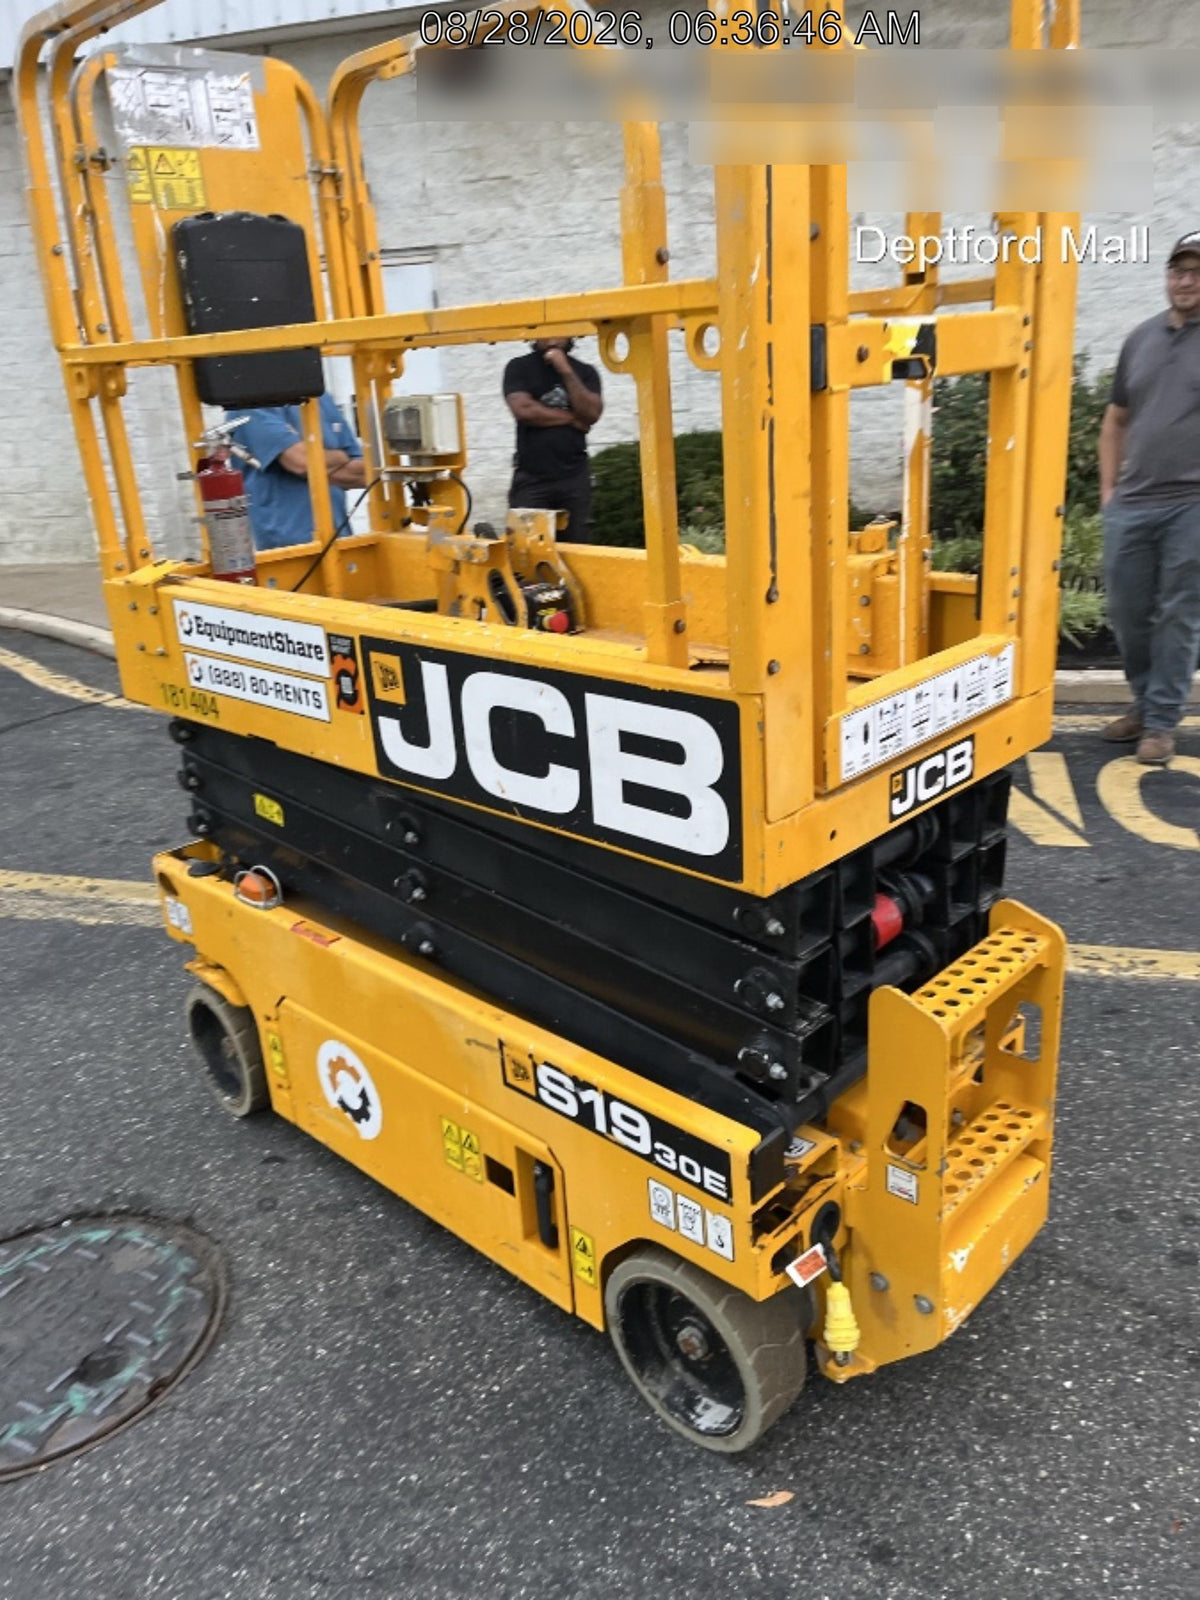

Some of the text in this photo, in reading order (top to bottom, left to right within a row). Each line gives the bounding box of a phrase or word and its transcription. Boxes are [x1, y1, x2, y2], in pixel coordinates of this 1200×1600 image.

[194, 615, 326, 661] EquipmentShare
[208, 665, 323, 710] (888) 80-RENTS
[378, 660, 730, 856] JCB
[891, 740, 975, 816] JCB
[536, 1064, 652, 1155] S19
